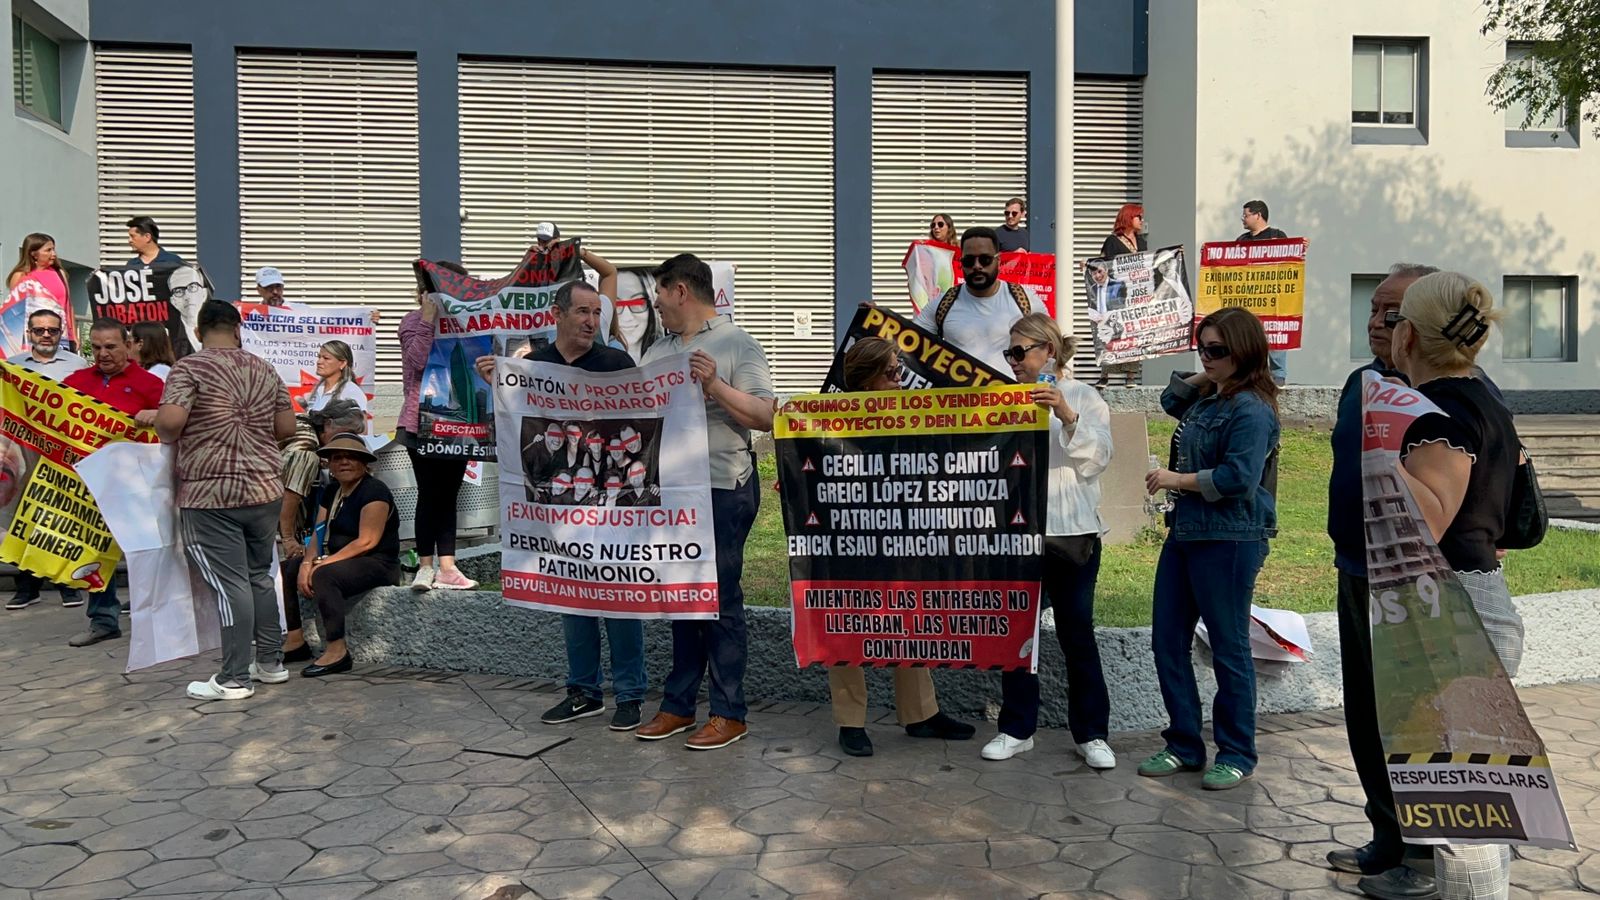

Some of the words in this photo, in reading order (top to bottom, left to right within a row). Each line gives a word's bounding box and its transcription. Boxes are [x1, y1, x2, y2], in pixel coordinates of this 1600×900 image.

[1225, 244, 1247, 259] MÁS
[1249, 243, 1304, 259] IMPUNIDAD!
[94, 266, 156, 304] JOSÉ
[1205, 271, 1243, 282] EXIGIMOS
[1246, 267, 1299, 281] EXTRADICIÓN
[1206, 286, 1217, 295] DE
[1219, 285, 1233, 295] LAS
[1235, 283, 1281, 295] CÓMPLICES
[1284, 284, 1296, 293] DE
[1121, 300, 1178, 321] REGRESEN
[1223, 297, 1267, 308] PROYECTOS
[1270, 297, 1276, 307] 9
[243, 313, 294, 324] JUSTICIA
[298, 316, 363, 326] SELECTIVA
[307, 325, 315, 334] 9
[319, 326, 373, 336] LOBATON
[466, 311, 557, 333] ABANDON
[1139, 312, 1181, 331] DINERO
[281, 350, 320, 358] NOSOTRO
[568, 384, 579, 395] Y
[585, 371, 684, 397] PROYECTOS
[527, 392, 555, 409] NOS
[560, 391, 671, 411] ENGAÑARON!
[865, 397, 896, 413] QUE
[901, 395, 931, 410] LOS
[936, 391, 1034, 408] VENDEDORE
[23, 400, 113, 450] VALADEZ
[788, 417, 807, 432] DE
[812, 415, 905, 432] PROYECTOS
[910, 415, 921, 429] 9
[925, 413, 956, 428] DEN
[961, 412, 982, 427] LA
[986, 409, 1037, 426] CARA!
[417, 441, 469, 456] ¿DÓNDE
[822, 453, 885, 477] CECILIA
[890, 452, 939, 476] FRIAS
[944, 445, 1000, 475] CANTÚ
[36, 464, 90, 501] CUMPLE
[817, 482, 867, 503] GREICI
[872, 476, 923, 502] LÓPEZ
[928, 478, 1009, 502] ESPINOZA
[20, 500, 30, 517] Y
[31, 507, 113, 553] DEVUELVAN
[830, 508, 903, 530] PATRICIA
[908, 507, 996, 530] HUIHUITOA
[11, 519, 26, 541] EL
[29, 528, 84, 562] DINERO
[510, 533, 594, 560] PERDIMOS
[600, 542, 702, 561] NUESTRO
[788, 535, 832, 557] ERICK
[836, 536, 877, 557] ESAU
[883, 529, 949, 557] CHACÓN
[955, 533, 1044, 557] GUAJARDO
[538, 557, 662, 584] PATRIMONIO.
[579, 588, 646, 603] NUESTRO
[651, 588, 718, 603] DINERO!
[804, 588, 883, 610] MIENTRAS
[888, 589, 917, 611] LAS
[922, 589, 1003, 611] ENTREGAS
[1008, 589, 1030, 612] NO
[1416, 574, 1441, 618] 9
[825, 613, 909, 637] LLEGABAN,
[914, 614, 945, 635] LAS
[949, 614, 1010, 636] VENTAS
[863, 638, 972, 661] CONTINUABAN
[1390, 769, 1487, 786] RESPUESTAS
[1488, 771, 1549, 789] CLARAS
